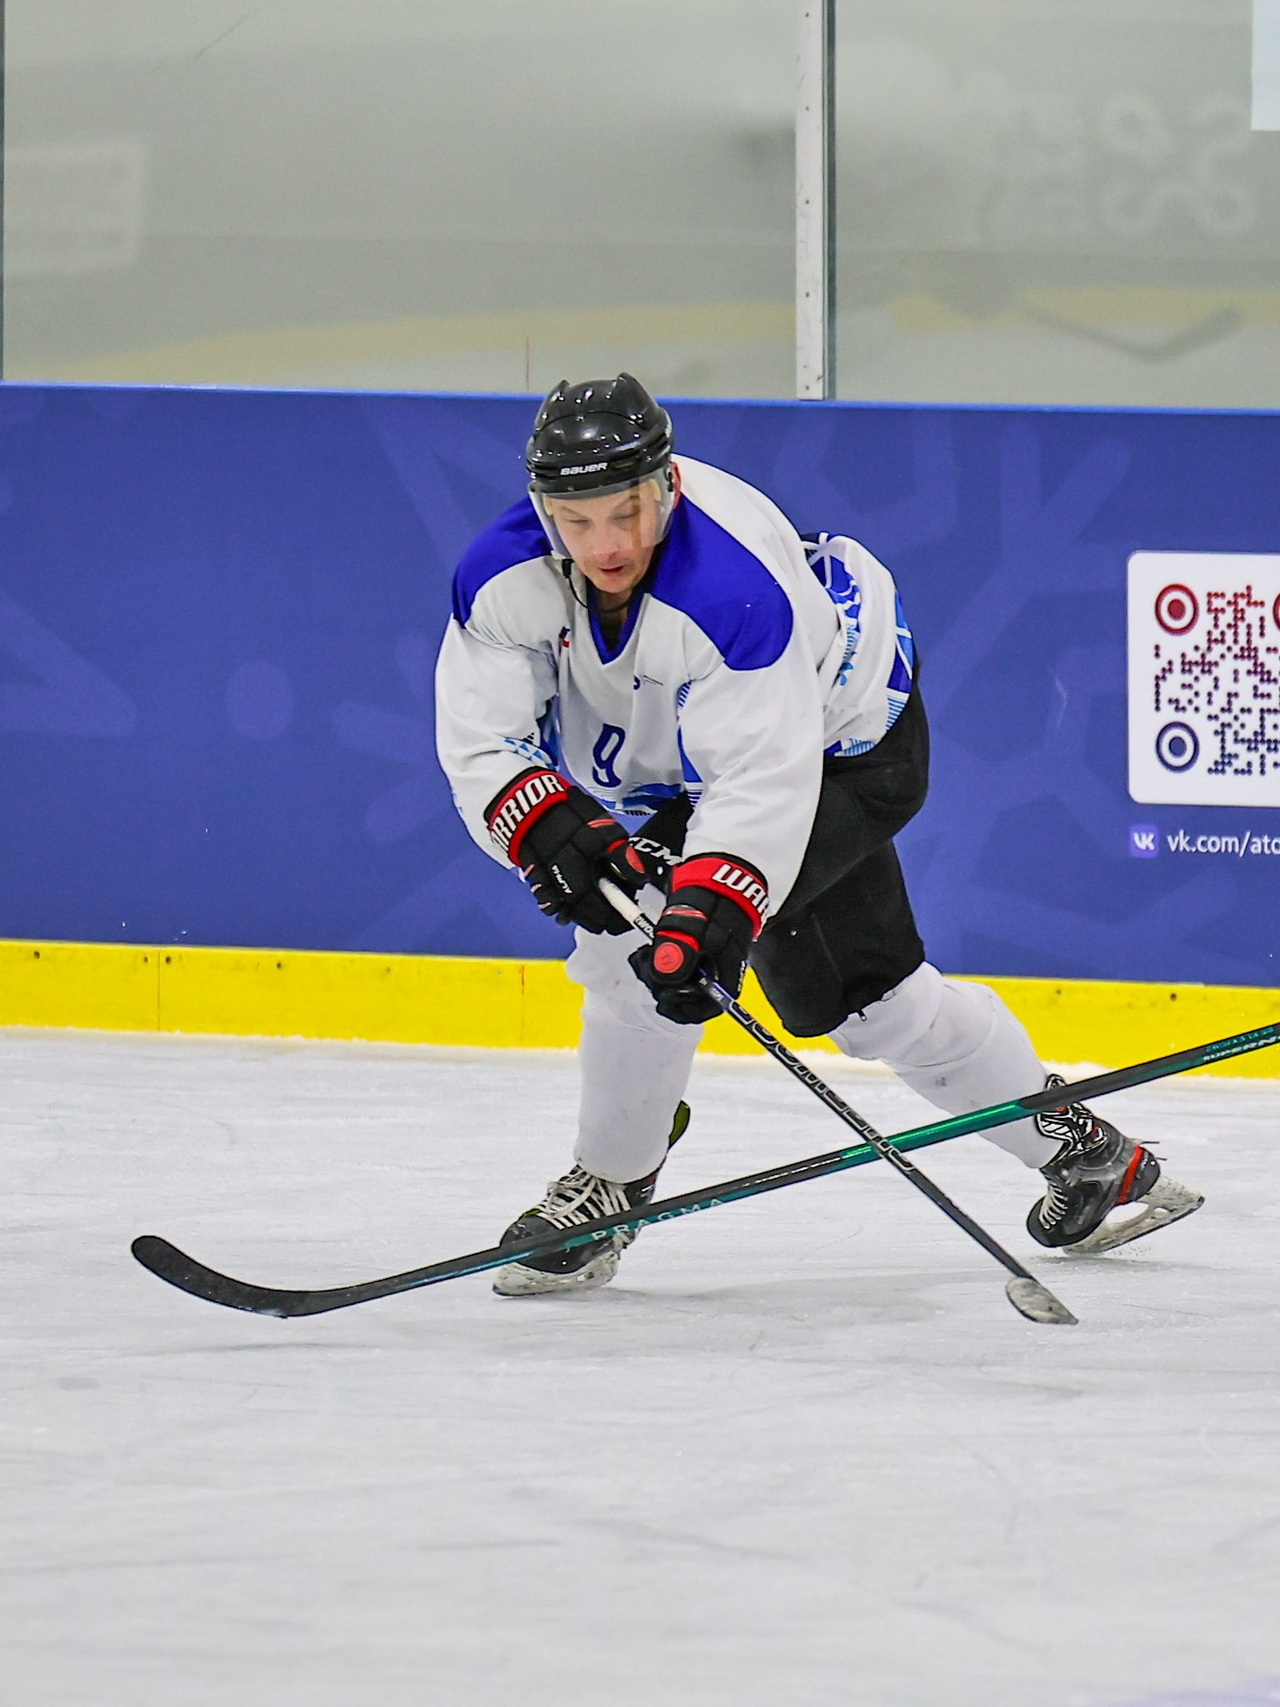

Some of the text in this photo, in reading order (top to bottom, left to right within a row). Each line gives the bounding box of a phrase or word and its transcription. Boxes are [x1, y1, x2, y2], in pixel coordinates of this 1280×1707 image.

[560, 462, 608, 476] BAUER
[592, 723, 627, 788] 9
[591, 1198, 725, 1242] PRAGMA
